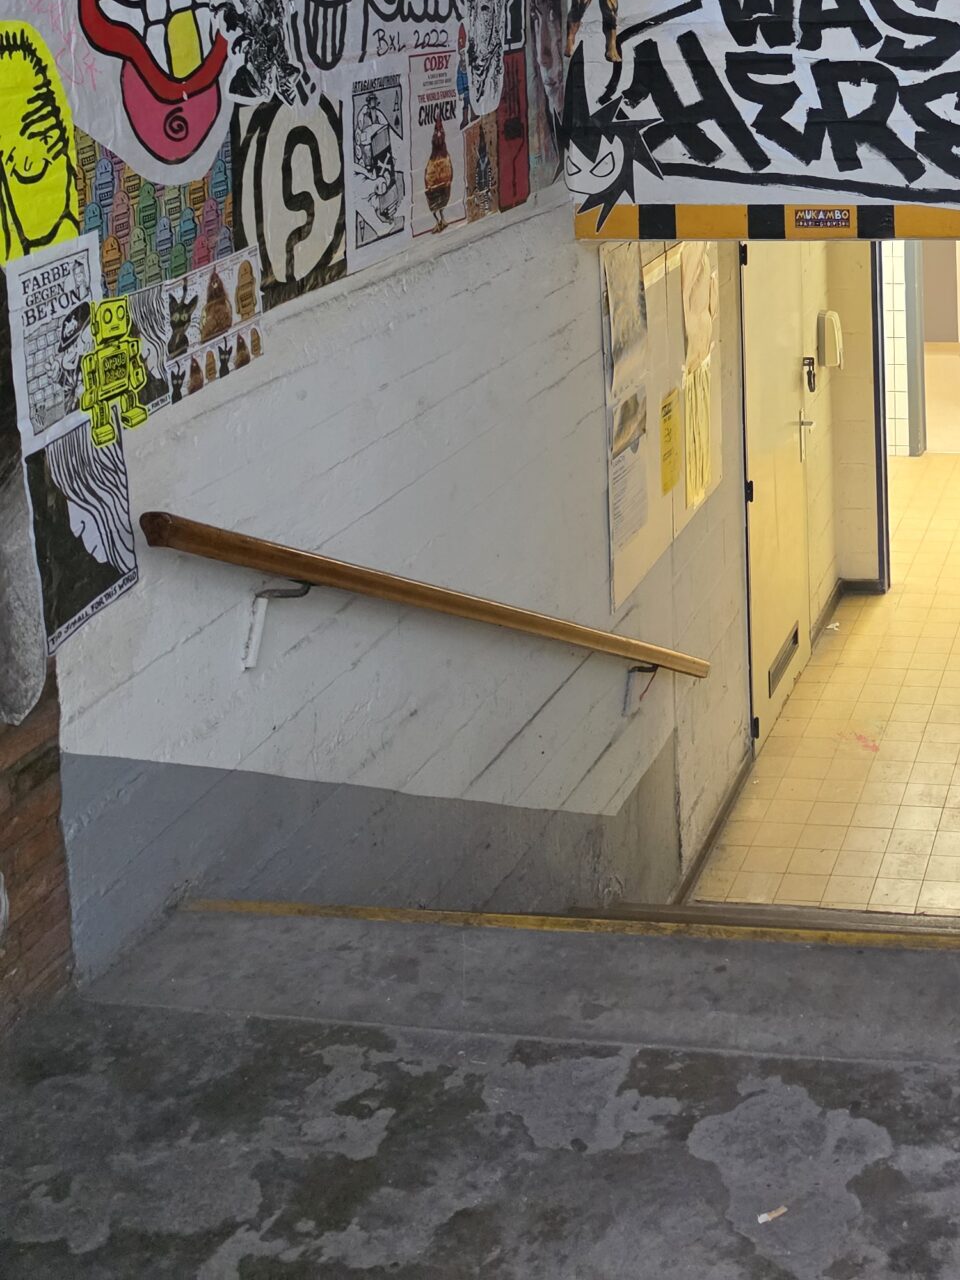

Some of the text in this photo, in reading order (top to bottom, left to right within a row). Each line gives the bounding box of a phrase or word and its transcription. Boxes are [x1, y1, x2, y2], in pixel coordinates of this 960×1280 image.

[424, 55, 452, 73] COBY
[418, 100, 458, 128] CHICKEN
[795, 209, 850, 220] MUKAMBO
[22, 261, 72, 296] FARBE
[22, 289, 82, 327] BETON
[25, 281, 66, 308] GEGEN
[63, 609, 91, 634] SMALL
[90, 595, 106, 613] FOR
[117, 571, 137, 591] WORLD
